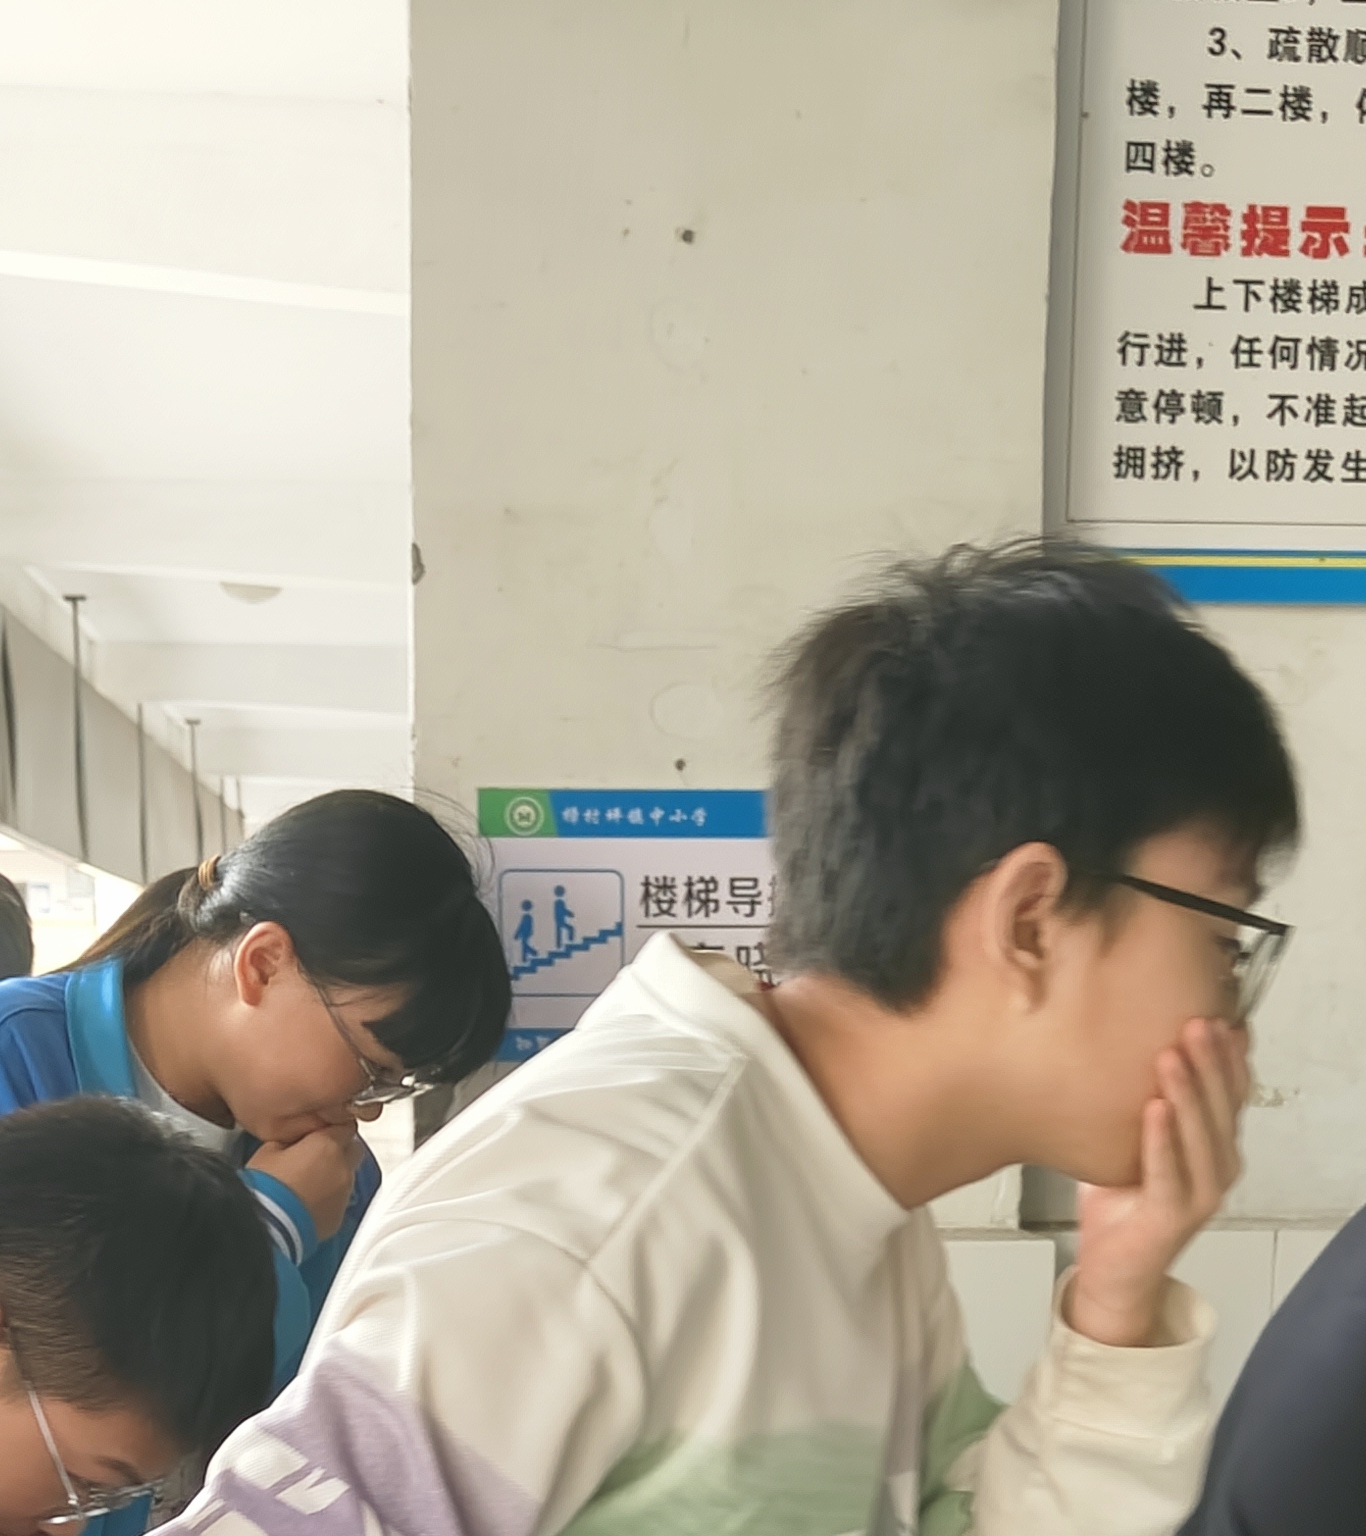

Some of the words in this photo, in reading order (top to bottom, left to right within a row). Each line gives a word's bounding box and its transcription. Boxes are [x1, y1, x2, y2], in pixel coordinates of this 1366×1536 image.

[1125, 139, 1215, 178] 四楼。
[639, 874, 775, 919] 楼梯导
